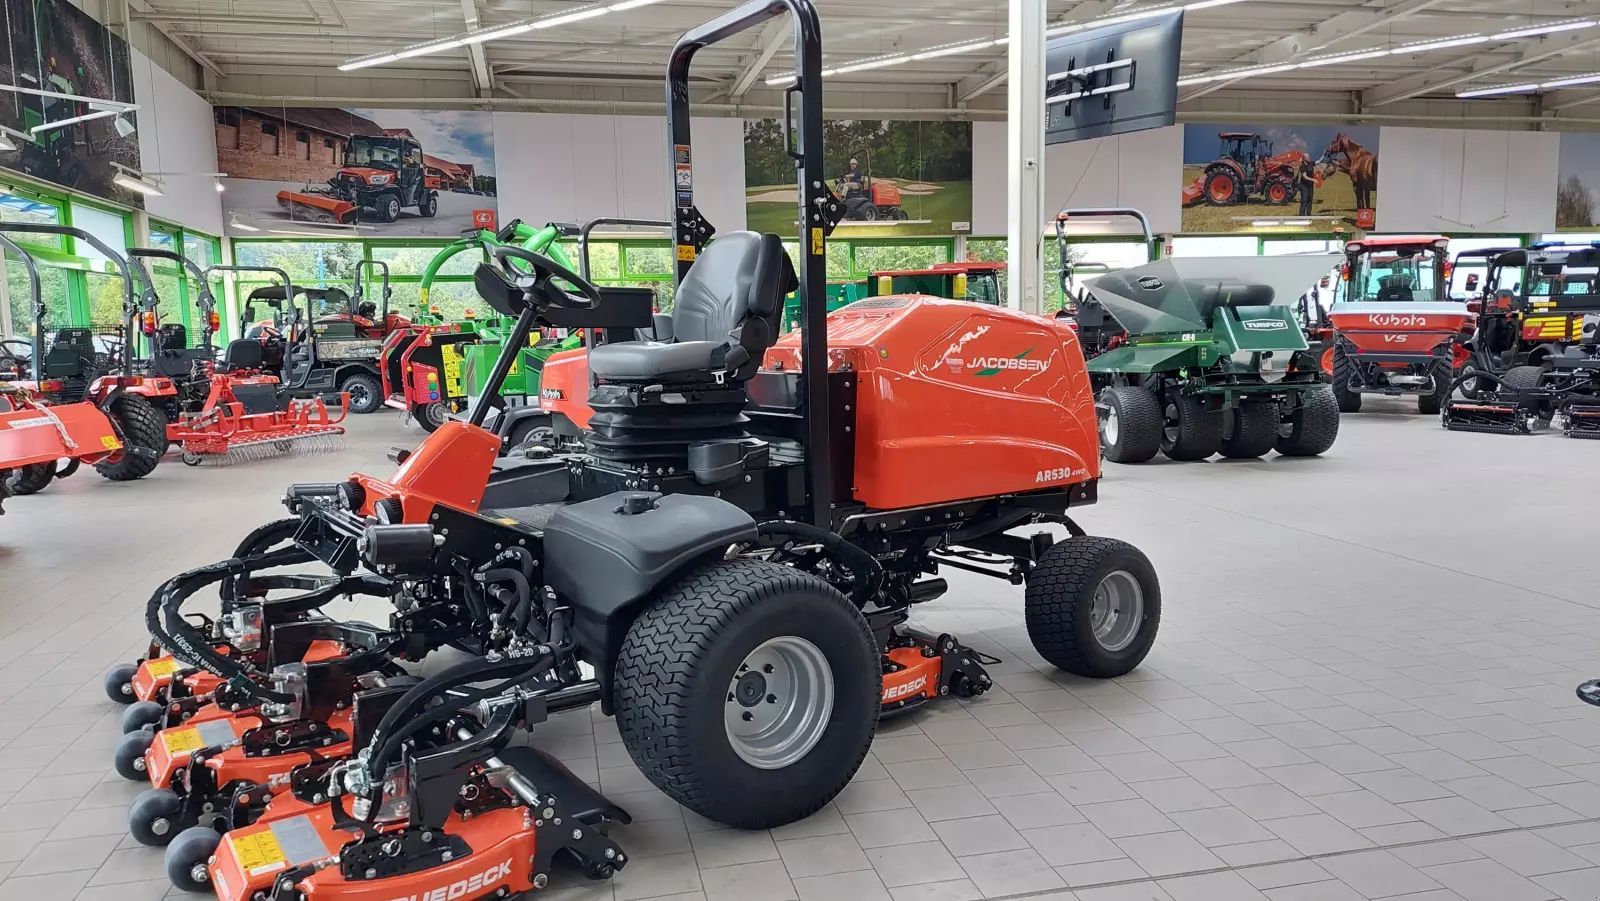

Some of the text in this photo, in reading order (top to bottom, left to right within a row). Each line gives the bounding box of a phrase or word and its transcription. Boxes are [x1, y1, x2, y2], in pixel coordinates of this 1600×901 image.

[1140, 279, 1161, 288] TURFCO
[1368, 314, 1426, 326] Kubota
[1384, 334, 1408, 343] VS
[966, 357, 1050, 371] JACOBSEN
[1035, 467, 1071, 483] AR530
[389, 857, 514, 901] EDECK
